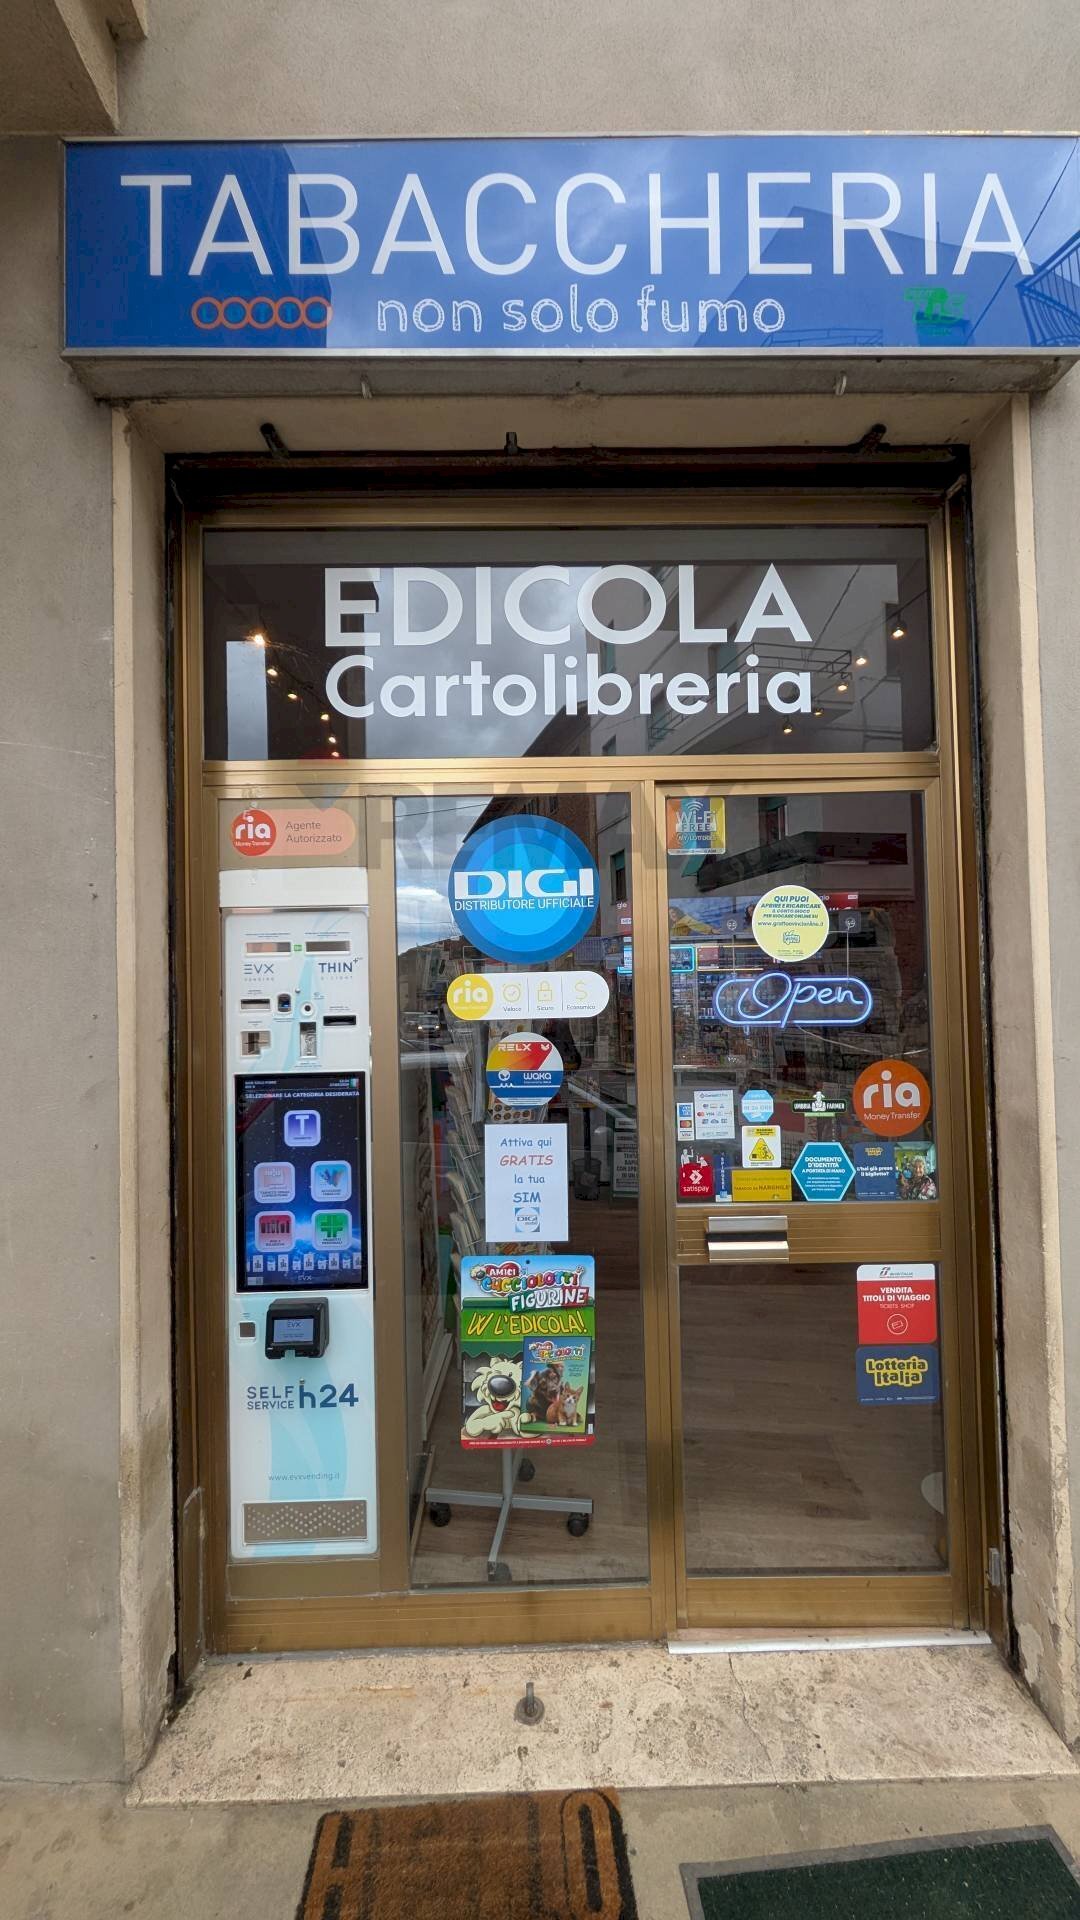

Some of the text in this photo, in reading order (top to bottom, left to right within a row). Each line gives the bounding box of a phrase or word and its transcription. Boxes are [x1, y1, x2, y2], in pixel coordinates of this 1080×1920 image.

[119, 172, 1034, 277] TABACCHERIA
[376, 284, 786, 333] non solo fumo
[324, 563, 812, 646] EDICOLA
[325, 654, 812, 718] Cartolibreria
[676, 810, 717, 824] Wi-Fi
[235, 815, 271, 839] ria
[285, 821, 321, 831] Agente
[681, 823, 711, 832] FREE
[286, 834, 343, 843] Autorizzato
[454, 868, 594, 899] DIGI
[455, 897, 594, 911] DISTRIBUTORE UFFICIALE
[789, 895, 810, 903] PUOI
[453, 980, 488, 1004] ria
[738, 972, 864, 1028] Open
[498, 1043, 532, 1052] RELX
[863, 1070, 921, 1109] ria
[864, 1111, 921, 1121] Money Transfer
[500, 1137, 552, 1149] Attiva qui
[500, 1155, 553, 1166] GRATIS
[514, 1174, 545, 1184] la tua
[683, 1185, 709, 1193] satispay
[513, 1192, 541, 1203] SIM
[489, 1268, 516, 1276] AMICI
[481, 1271, 578, 1292] CUCCIOLOTTI
[511, 1288, 587, 1312] FIGURINE
[494, 1310, 587, 1335] L'EDICOLA!
[868, 1356, 926, 1371] Lotteria
[247, 1386, 294, 1399] SELF
[299, 1383, 359, 1408] h24
[247, 1400, 294, 1410] SERVICE
